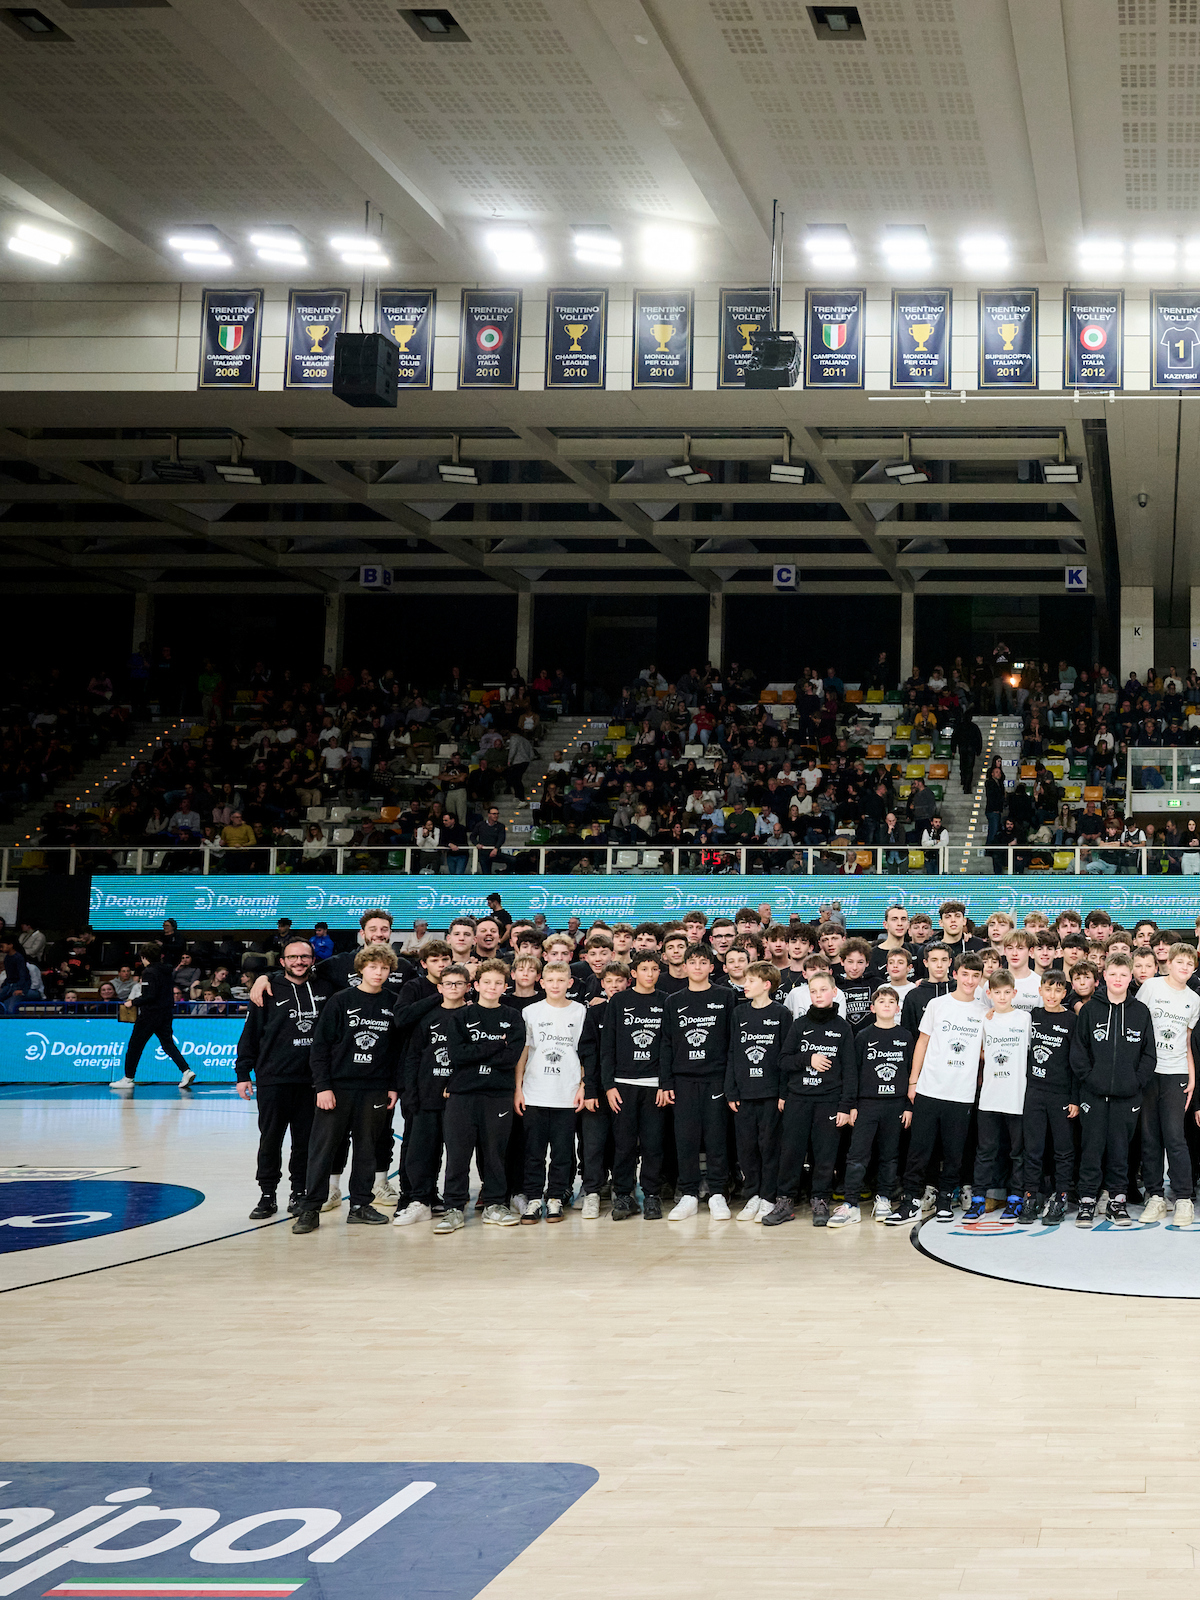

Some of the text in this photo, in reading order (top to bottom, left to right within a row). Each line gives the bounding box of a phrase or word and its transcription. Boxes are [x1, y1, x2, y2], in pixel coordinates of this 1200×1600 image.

[215, 314, 249, 322] VOLLEY
[302, 314, 336, 322] VOLLEY
[387, 314, 421, 322] VOLLEY
[474, 314, 508, 322] VOLLEY
[1163, 314, 1197, 322] VOLLEY
[1174, 340, 1184, 359] 1
[216, 368, 240, 377] 2008
[303, 369, 327, 377] 2009
[476, 368, 499, 377] 2010
[563, 368, 587, 376] 2010
[650, 368, 674, 376] 2010
[822, 368, 846, 376] 2011
[909, 368, 933, 376] 2011
[996, 368, 1020, 376] 2011
[1081, 368, 1105, 376] 2012
[363, 568, 377, 583] B
[777, 568, 792, 583] C
[1069, 570, 1083, 585] K
[1134, 627, 1141, 635] K
[105, 895, 168, 906] Dolomiti
[216, 895, 279, 906] Dolomiti
[328, 895, 391, 906] Dolomiti
[124, 908, 165, 918] energia
[235, 908, 277, 918] energia
[688, 1016, 716, 1024] Dolomiti
[51, 1041, 124, 1056] Dolomiti
[181, 1041, 238, 1055] Dolom
[73, 1056, 121, 1069] energia
